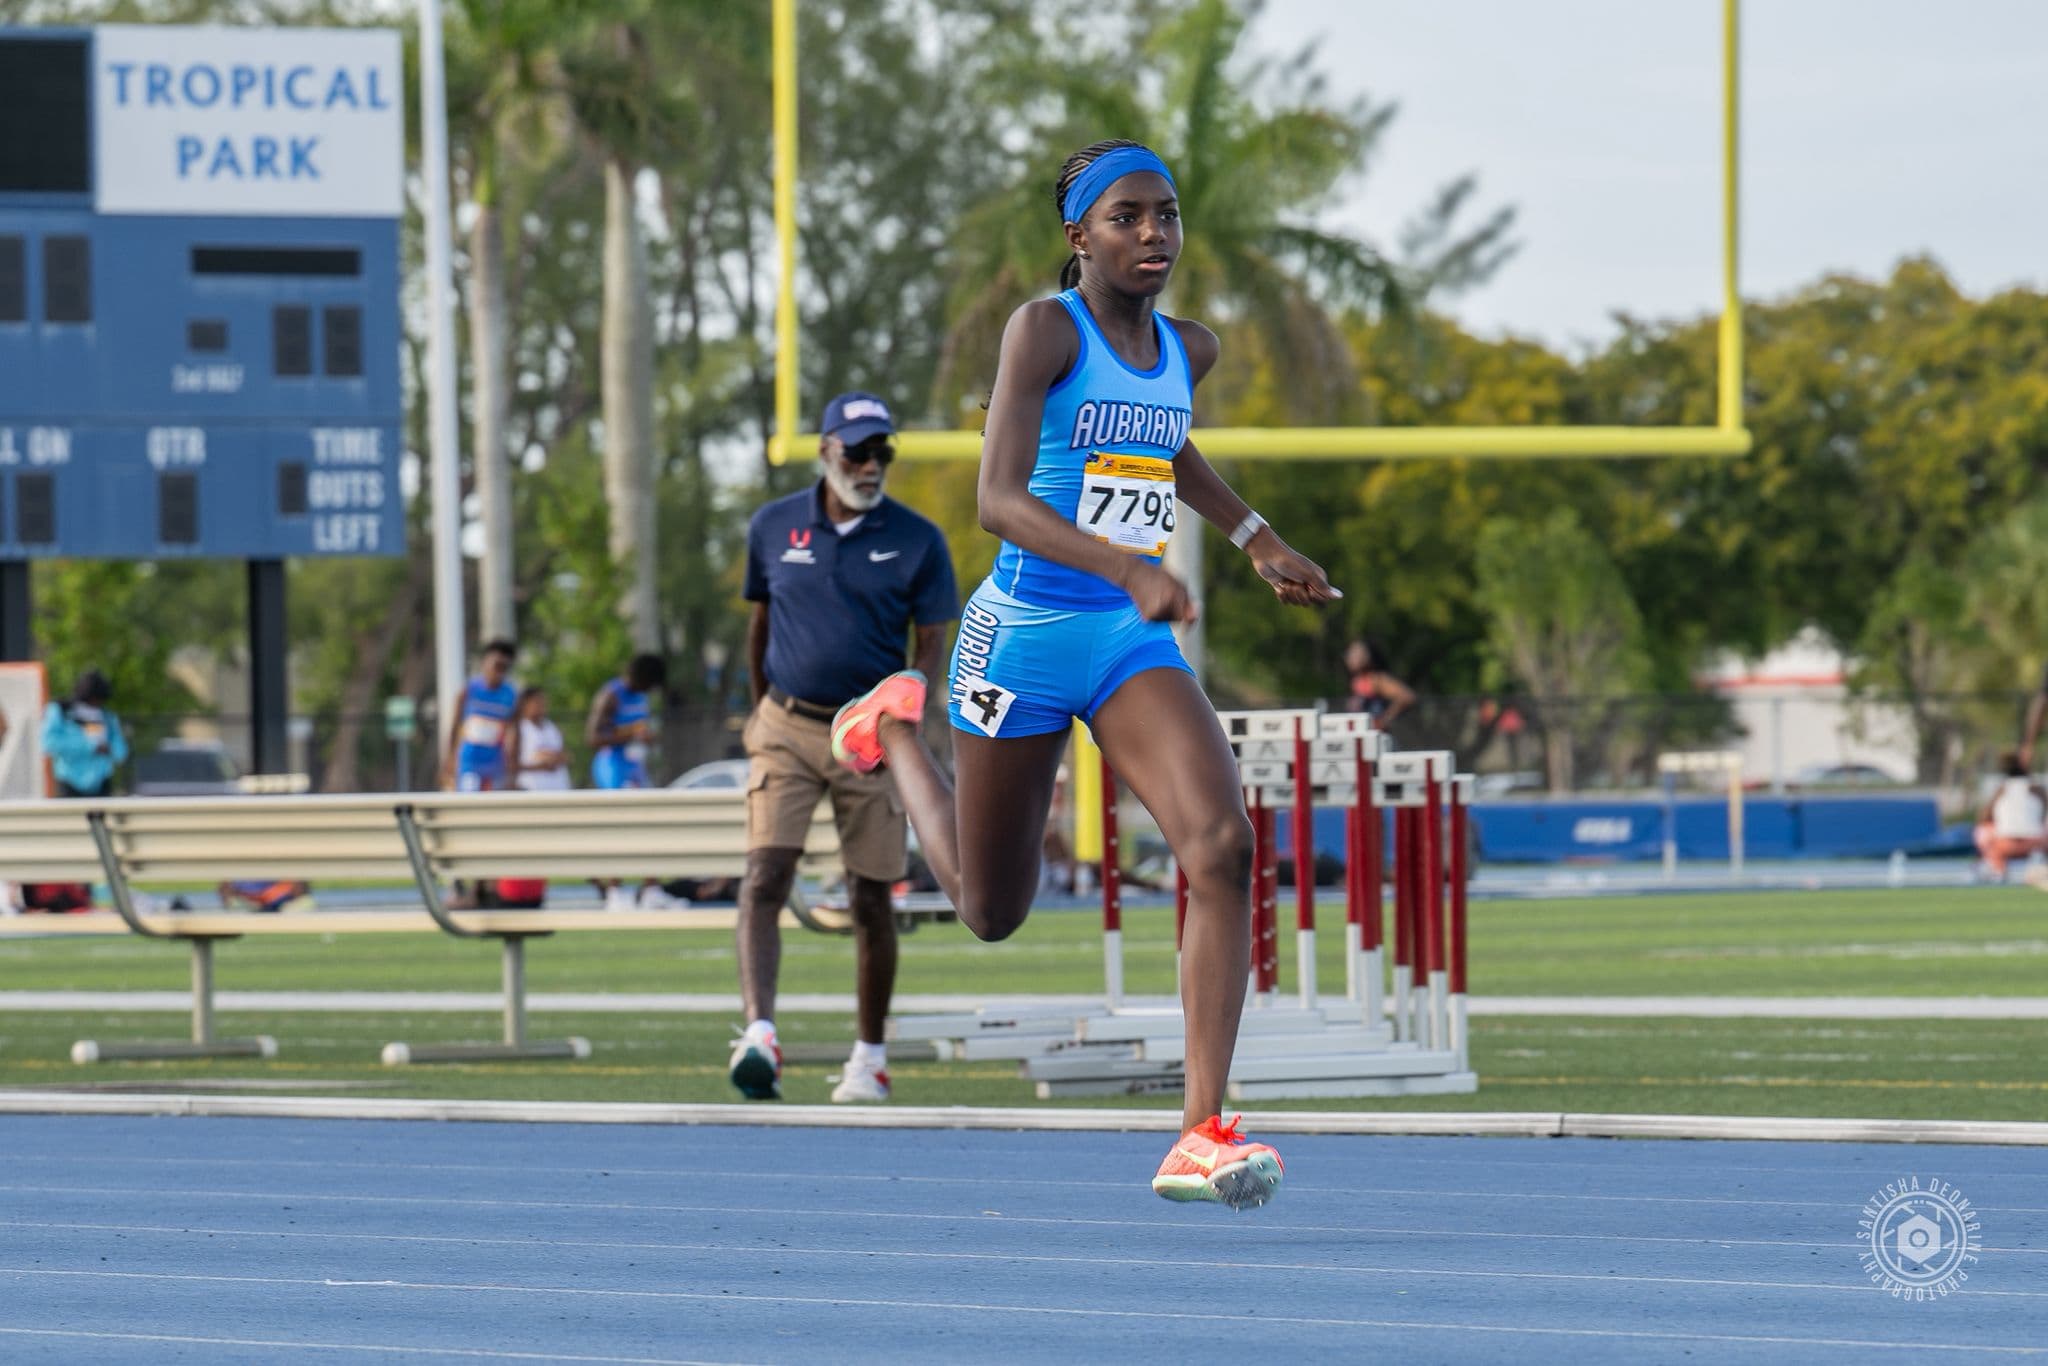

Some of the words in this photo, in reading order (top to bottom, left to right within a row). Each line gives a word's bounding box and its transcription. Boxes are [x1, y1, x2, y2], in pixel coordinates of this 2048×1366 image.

[109, 63, 391, 109] TROPICAL
[177, 135, 321, 179] PARK
[147, 426, 206, 471] QTR
[310, 427, 384, 465] TIME
[308, 470, 384, 508] OUTS
[1088, 485, 1175, 533] 7798
[312, 514, 382, 552] LEFT
[970, 688, 1003, 726] 4
